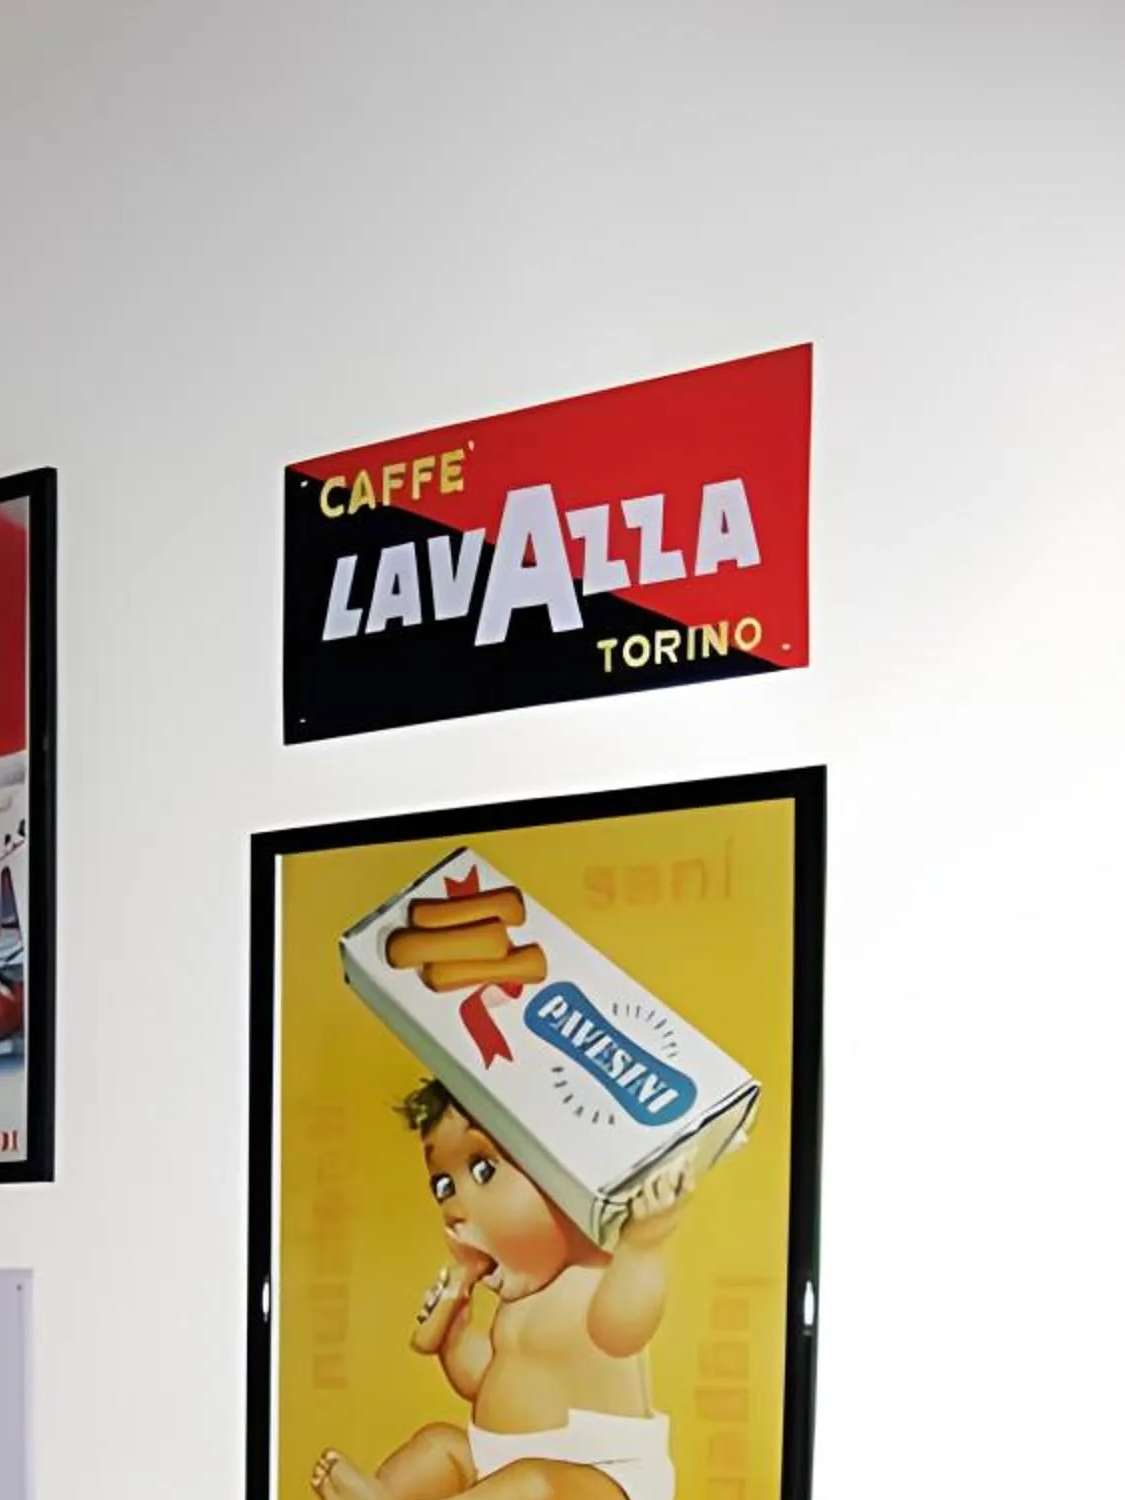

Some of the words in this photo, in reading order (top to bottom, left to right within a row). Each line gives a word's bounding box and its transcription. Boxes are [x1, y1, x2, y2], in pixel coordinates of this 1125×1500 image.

[322, 478, 761, 646] LAVAZZA
[597, 617, 762, 672] TORINO
[537, 995, 680, 1114] PAVESINI
